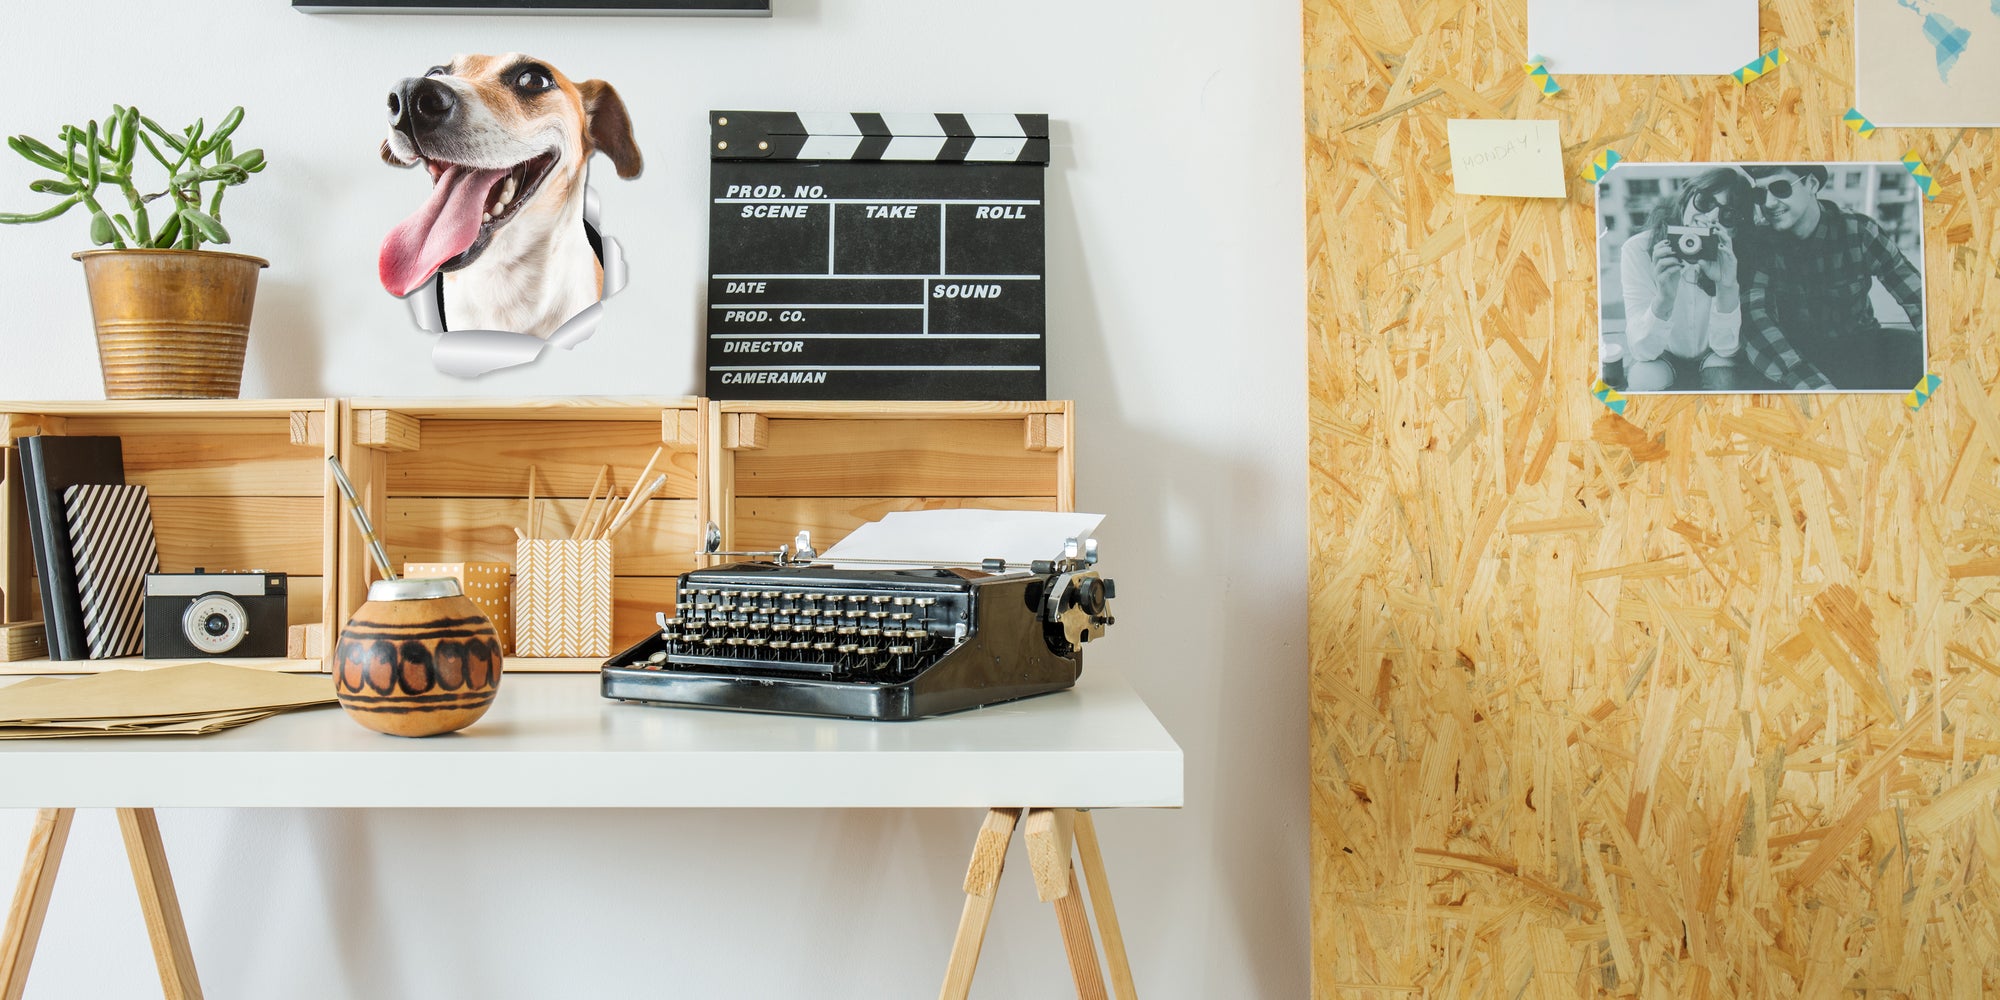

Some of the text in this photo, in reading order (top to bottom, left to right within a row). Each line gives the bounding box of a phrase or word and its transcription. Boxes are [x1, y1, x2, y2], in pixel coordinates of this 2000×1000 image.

[726, 185, 828, 199] PROD. NO.
[741, 205, 809, 219] SCENE
[865, 205, 918, 219] TAKE
[975, 206, 1027, 220] ROLL
[725, 282, 767, 294] DATE
[932, 284, 1002, 299] SOUND
[724, 310, 806, 323] PROD. CO.
[723, 341, 804, 353] DIRECTOR
[721, 372, 827, 384] CAMERAMAN
